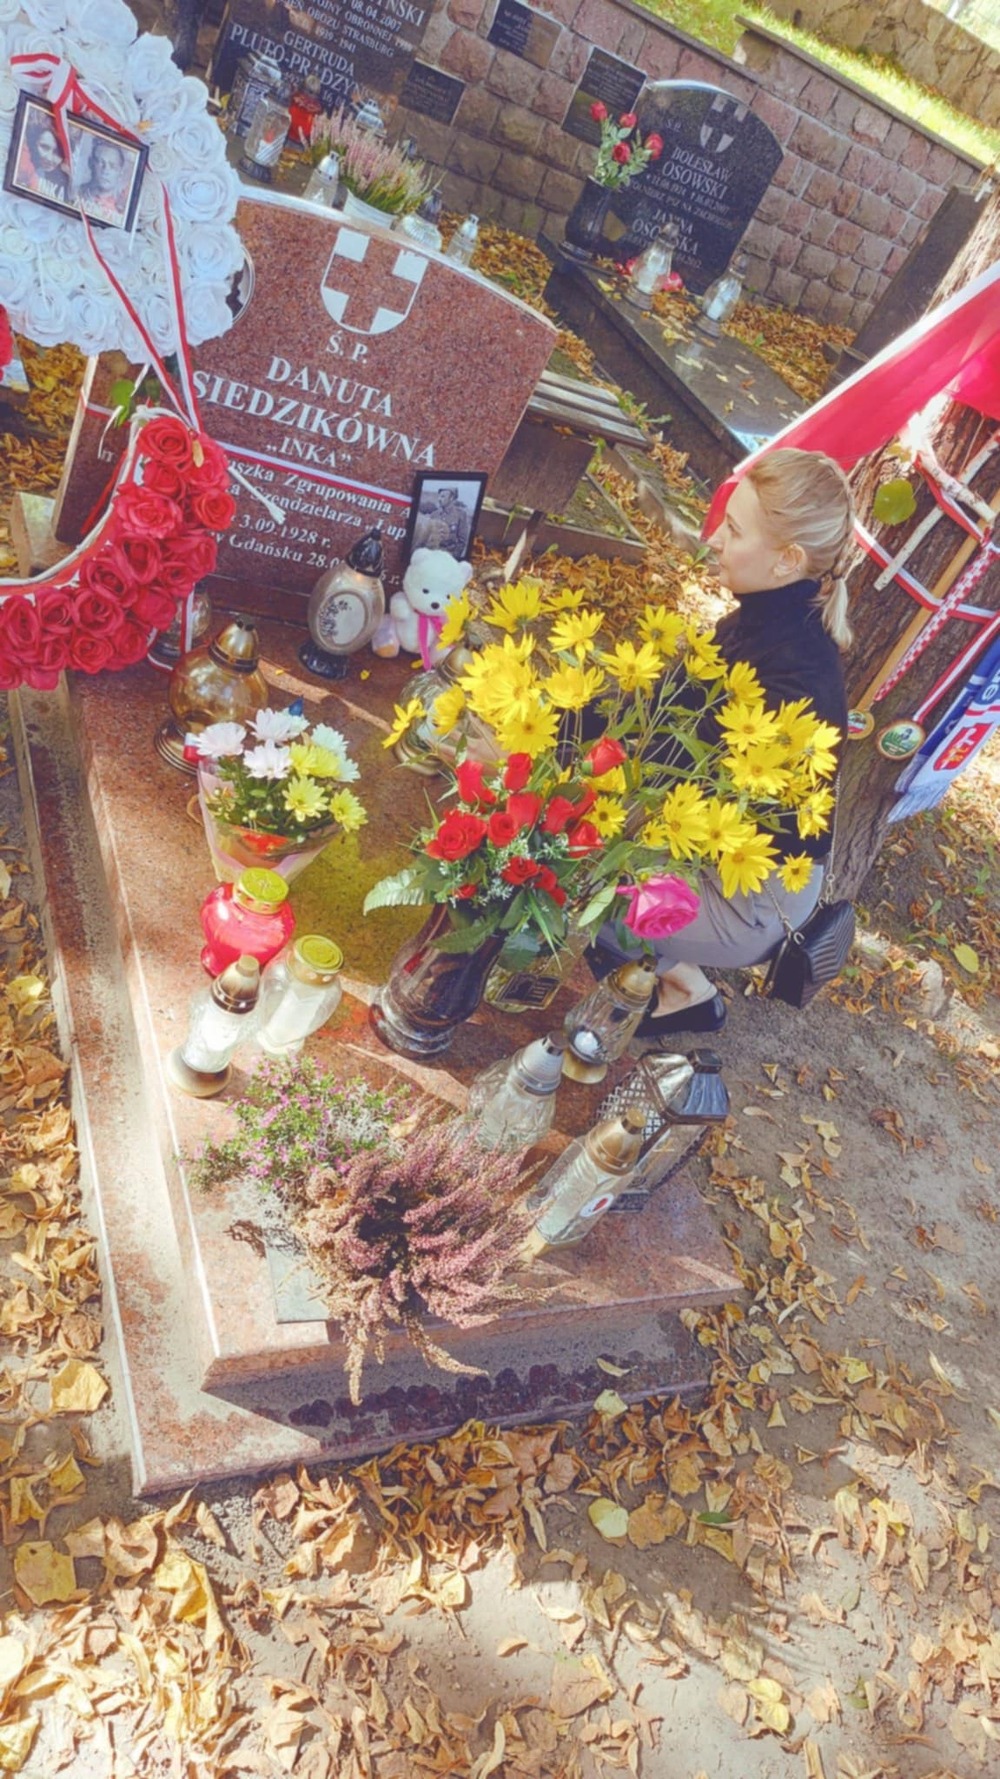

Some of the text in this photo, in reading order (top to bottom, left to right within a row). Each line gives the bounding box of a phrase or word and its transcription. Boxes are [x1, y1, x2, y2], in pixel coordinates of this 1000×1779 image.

[283, 30, 355, 77] GERTRUDA
[306, 6, 395, 58] OBOZU STRASBURG
[662, 160, 728, 200] OSOWSKI
[631, 218, 700, 256] OSOSKA
[266, 356, 394, 417] DANUTA
[193, 370, 438, 468] SIEDZIKÓWNA
[283, 472, 393, 514] Zgrupowania
[228, 534, 303, 562] Gdańsku
